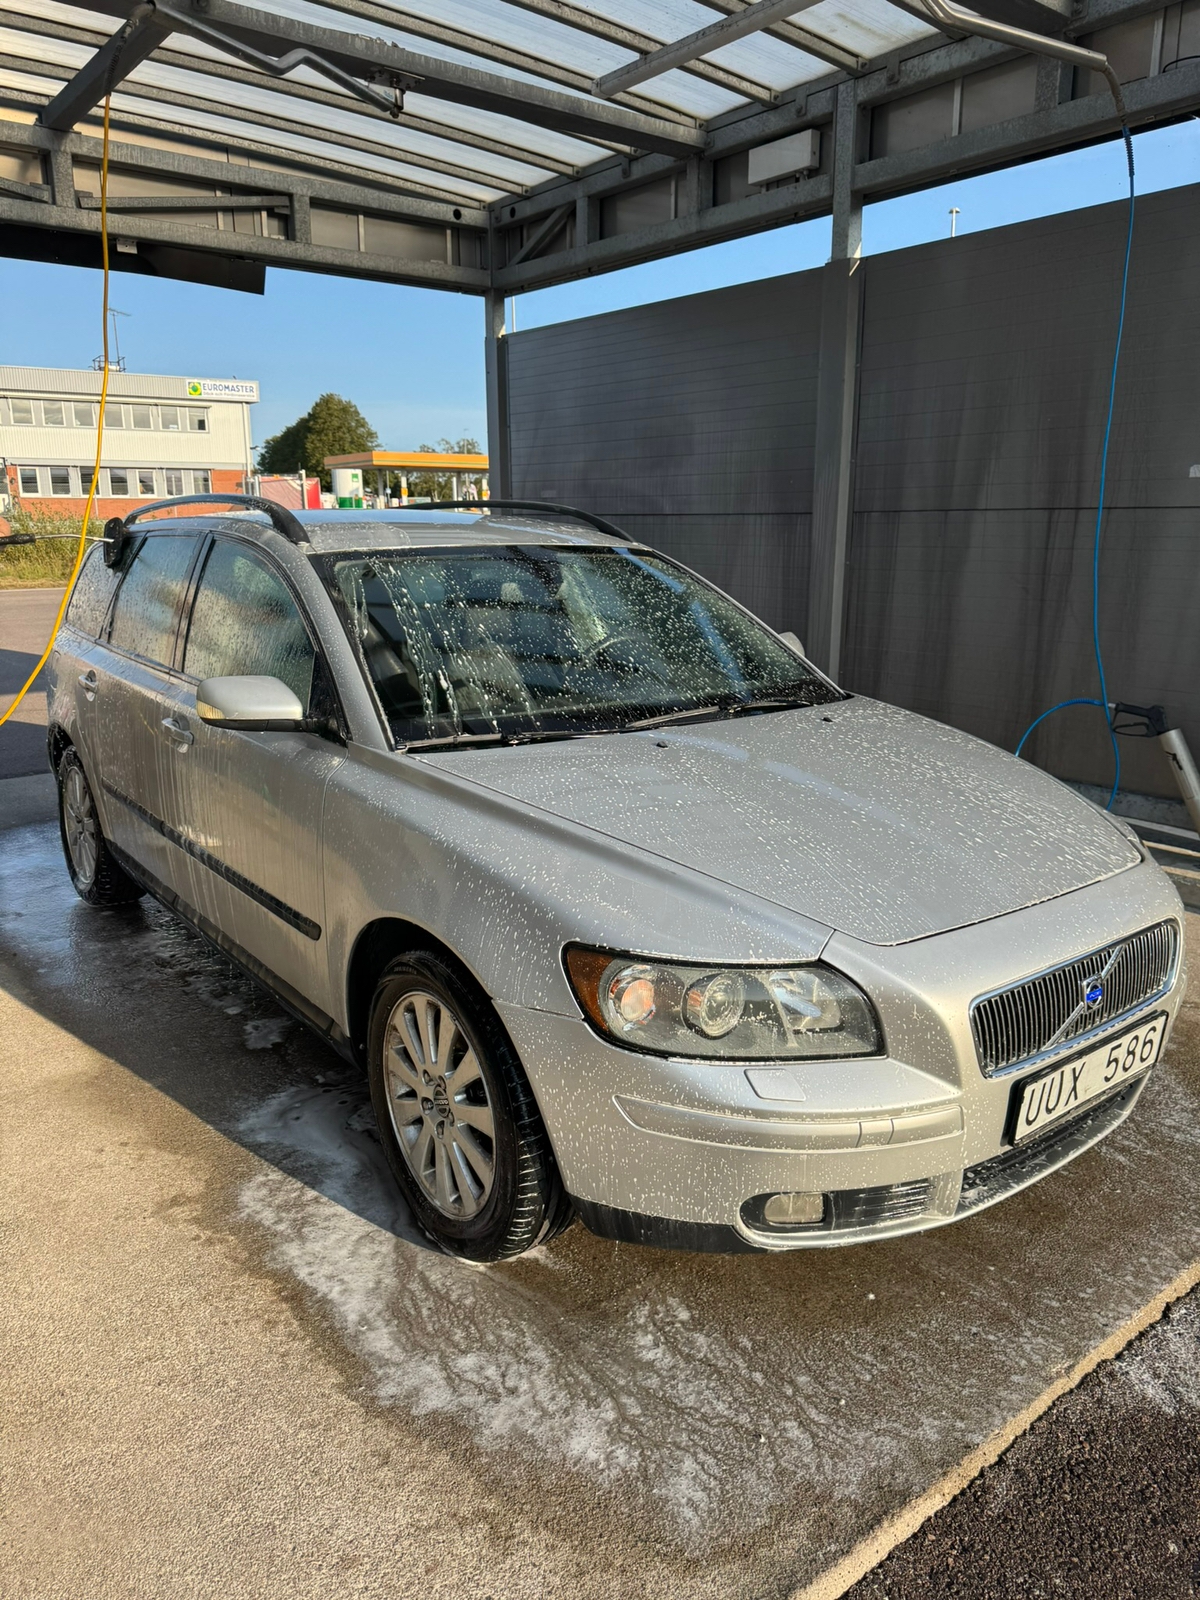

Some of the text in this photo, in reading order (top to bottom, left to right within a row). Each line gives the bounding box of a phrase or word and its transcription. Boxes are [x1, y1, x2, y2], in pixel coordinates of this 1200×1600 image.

[202, 383, 255, 393] EUROMASTER
[1025, 1025, 1157, 1127] UUX 586
